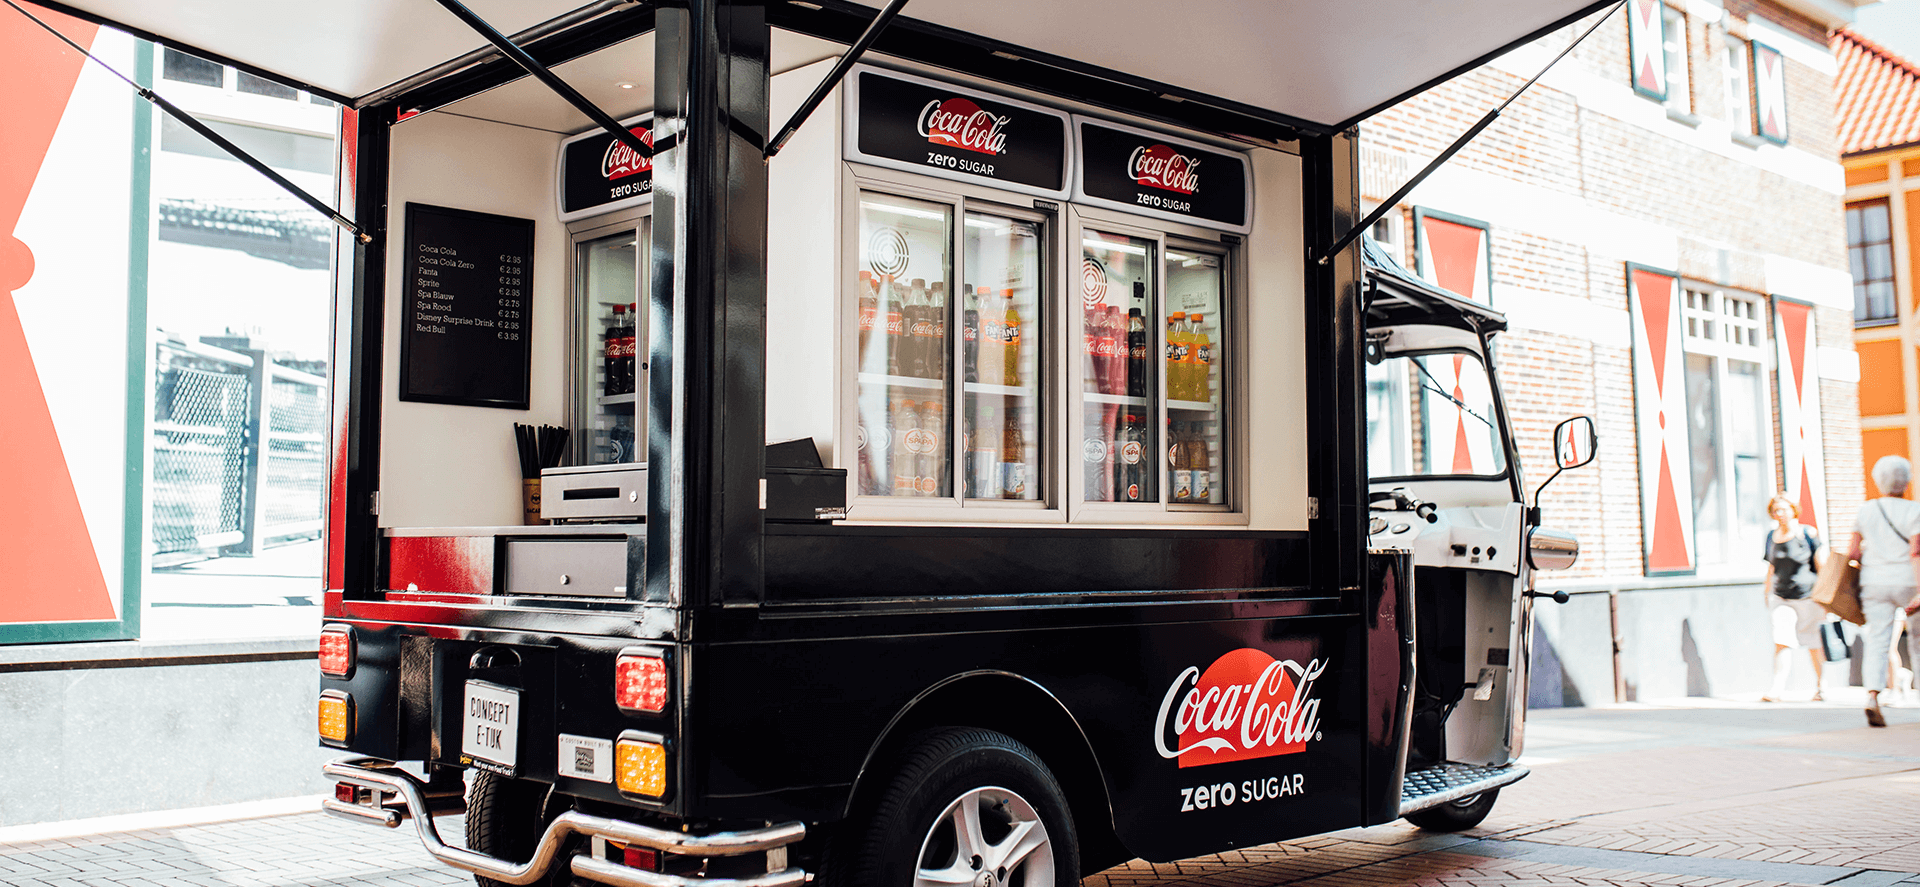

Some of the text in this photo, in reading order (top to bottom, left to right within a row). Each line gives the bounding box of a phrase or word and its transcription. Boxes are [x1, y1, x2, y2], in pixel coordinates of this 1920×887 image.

[927, 151, 995, 176] zero SUGAR
[610, 183, 632, 199] zero
[1136, 192, 1191, 213] zero SUGAR
[419, 244, 522, 264] Coca Cola € 2.95
[418, 255, 521, 275] Coca Cola Zero € 2.95
[418, 266, 521, 286] Fanta € 2.95
[417, 278, 521, 297] Sprite € 2.95
[417, 289, 520, 308] Spa Blauw € 2.75
[417, 301, 520, 319] Spa Rood € 2.75
[416, 312, 519, 330] Disney Surprise Drink € 2.95
[416, 323, 519, 341] Red Bull € 3.95
[470, 696, 510, 725] CONCEPT
[476, 724, 502, 751] E-TUK
[1180, 773, 1305, 813] zero SUGAR
